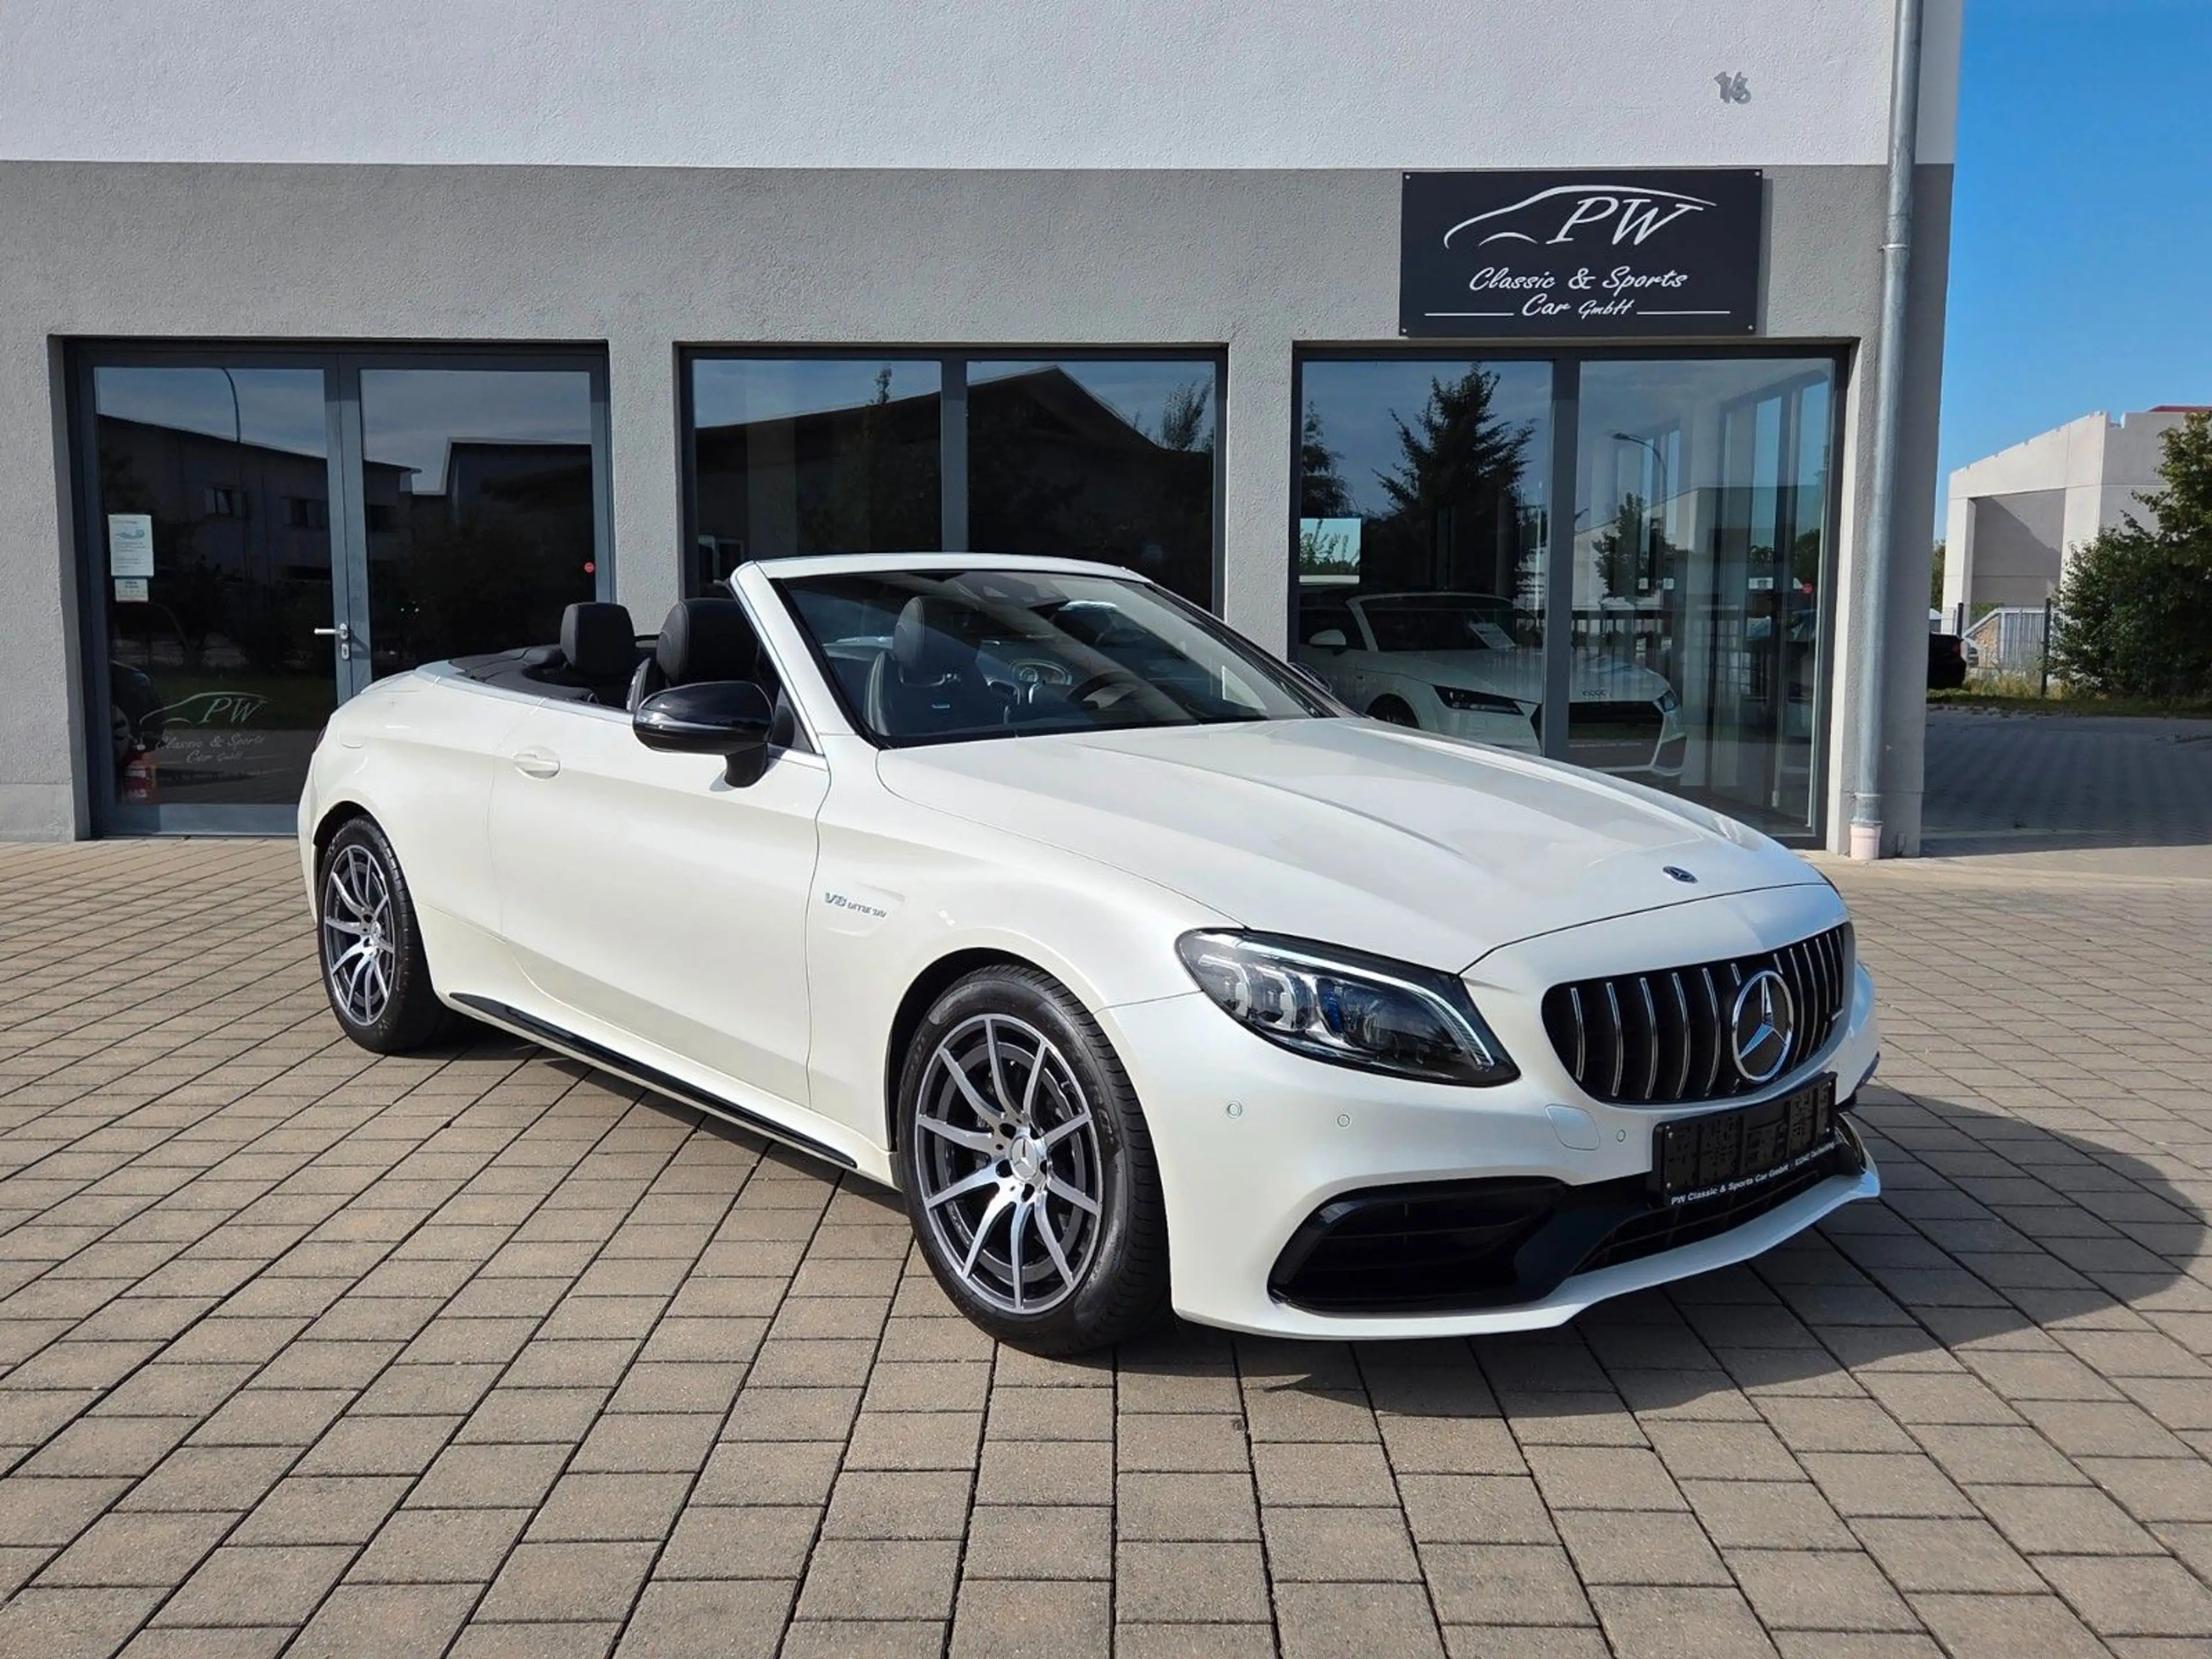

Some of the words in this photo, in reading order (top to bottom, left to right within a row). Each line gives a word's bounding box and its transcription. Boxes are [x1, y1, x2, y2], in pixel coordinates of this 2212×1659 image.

[1714, 71, 1751, 104] 16
[1546, 196, 1704, 245] PW
[1469, 267, 1556, 290] Classic
[1567, 268, 1596, 289] &
[1602, 266, 1688, 296] Sports
[1521, 293, 1571, 317] Car
[1578, 299, 1635, 319] GmbH
[198, 697, 269, 724] PW
[1671, 1194, 1687, 1205] PW
[1688, 1187, 1718, 1201] Classic
[1719, 1184, 1727, 1193] &
[1728, 1177, 1754, 1191] Sports
[1755, 1173, 1768, 1183] Car
